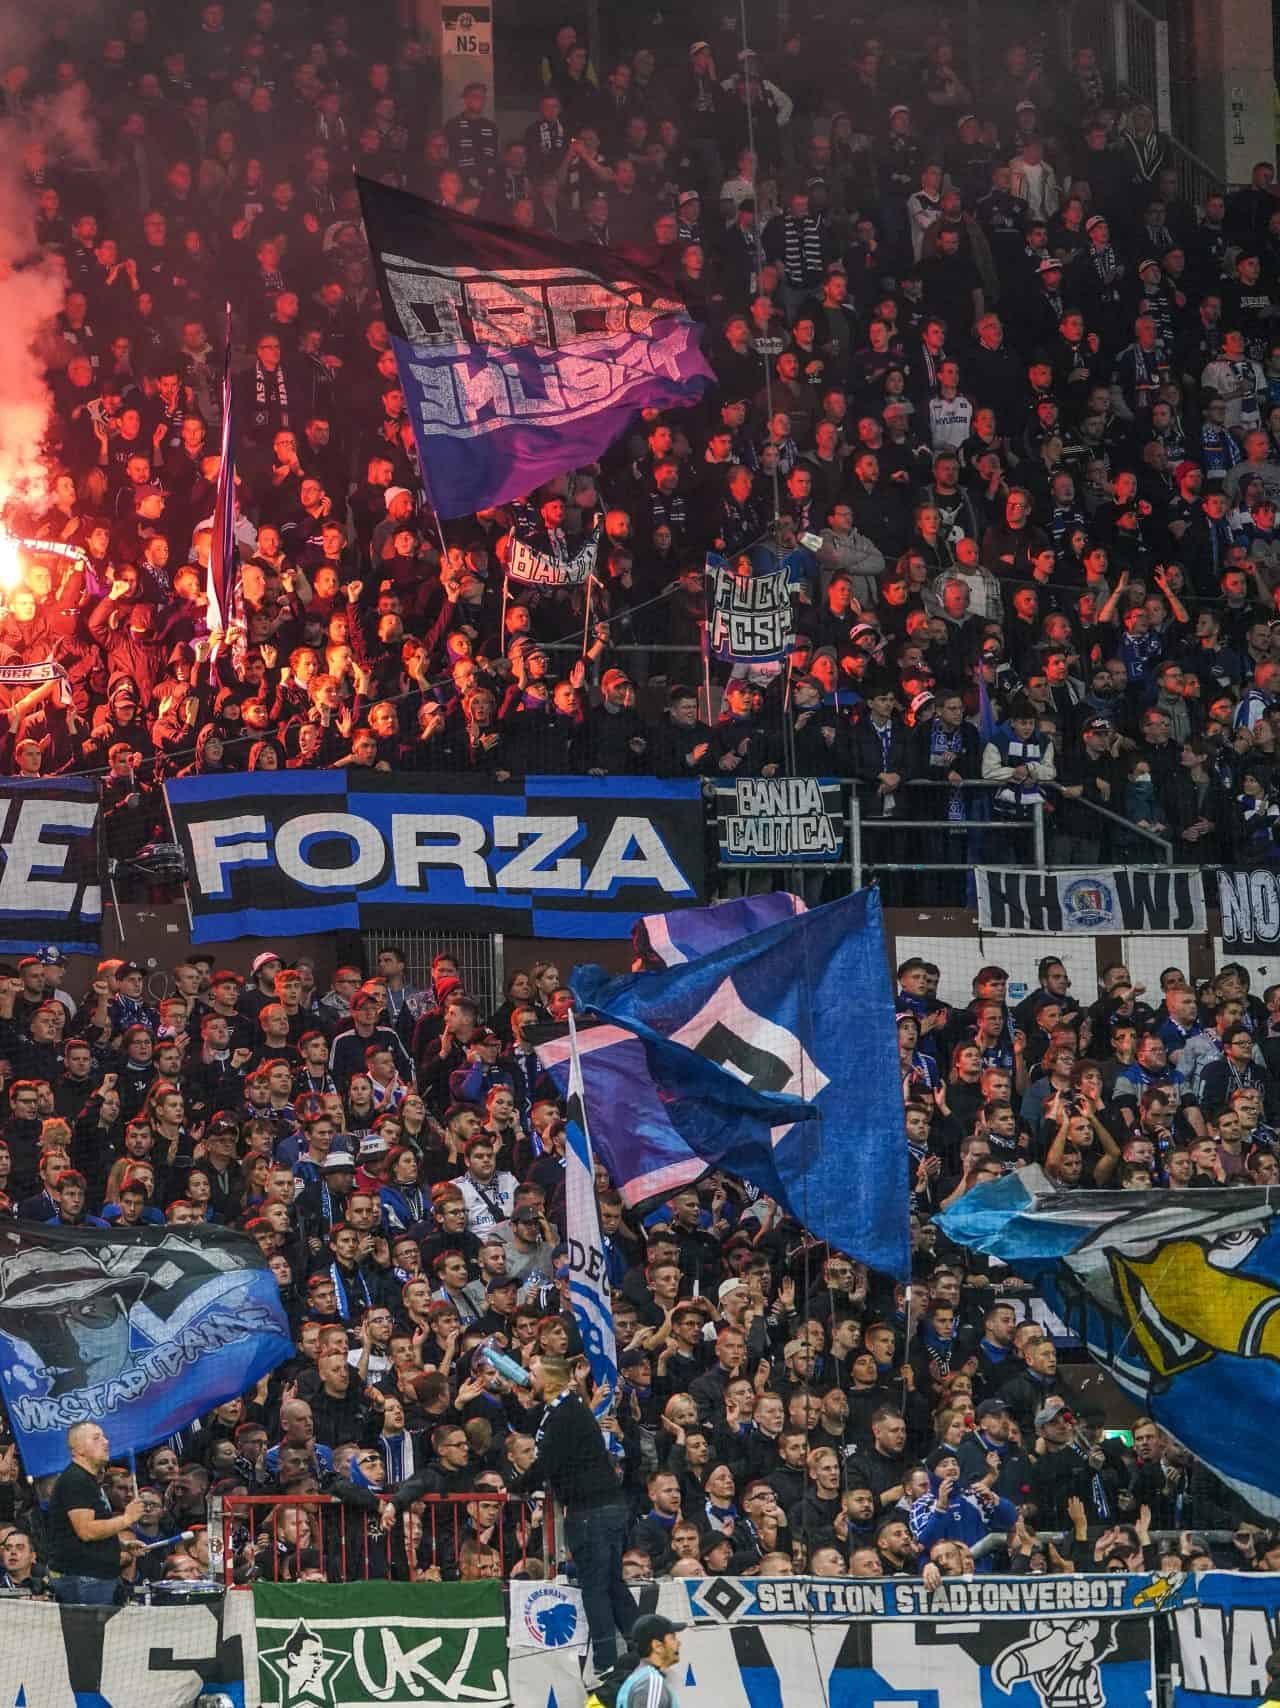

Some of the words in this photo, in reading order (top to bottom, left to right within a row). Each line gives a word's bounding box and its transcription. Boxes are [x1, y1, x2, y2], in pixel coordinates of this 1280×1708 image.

[456, 35, 477, 52] N5
[719, 566, 790, 612] FUCK
[736, 777, 824, 818] BANDA
[187, 812, 692, 895] FORZA
[728, 815, 838, 856] CAOTICA
[756, 1582, 888, 1612] SEKTION
[895, 1577, 1128, 1613] STADIONVERBOT
